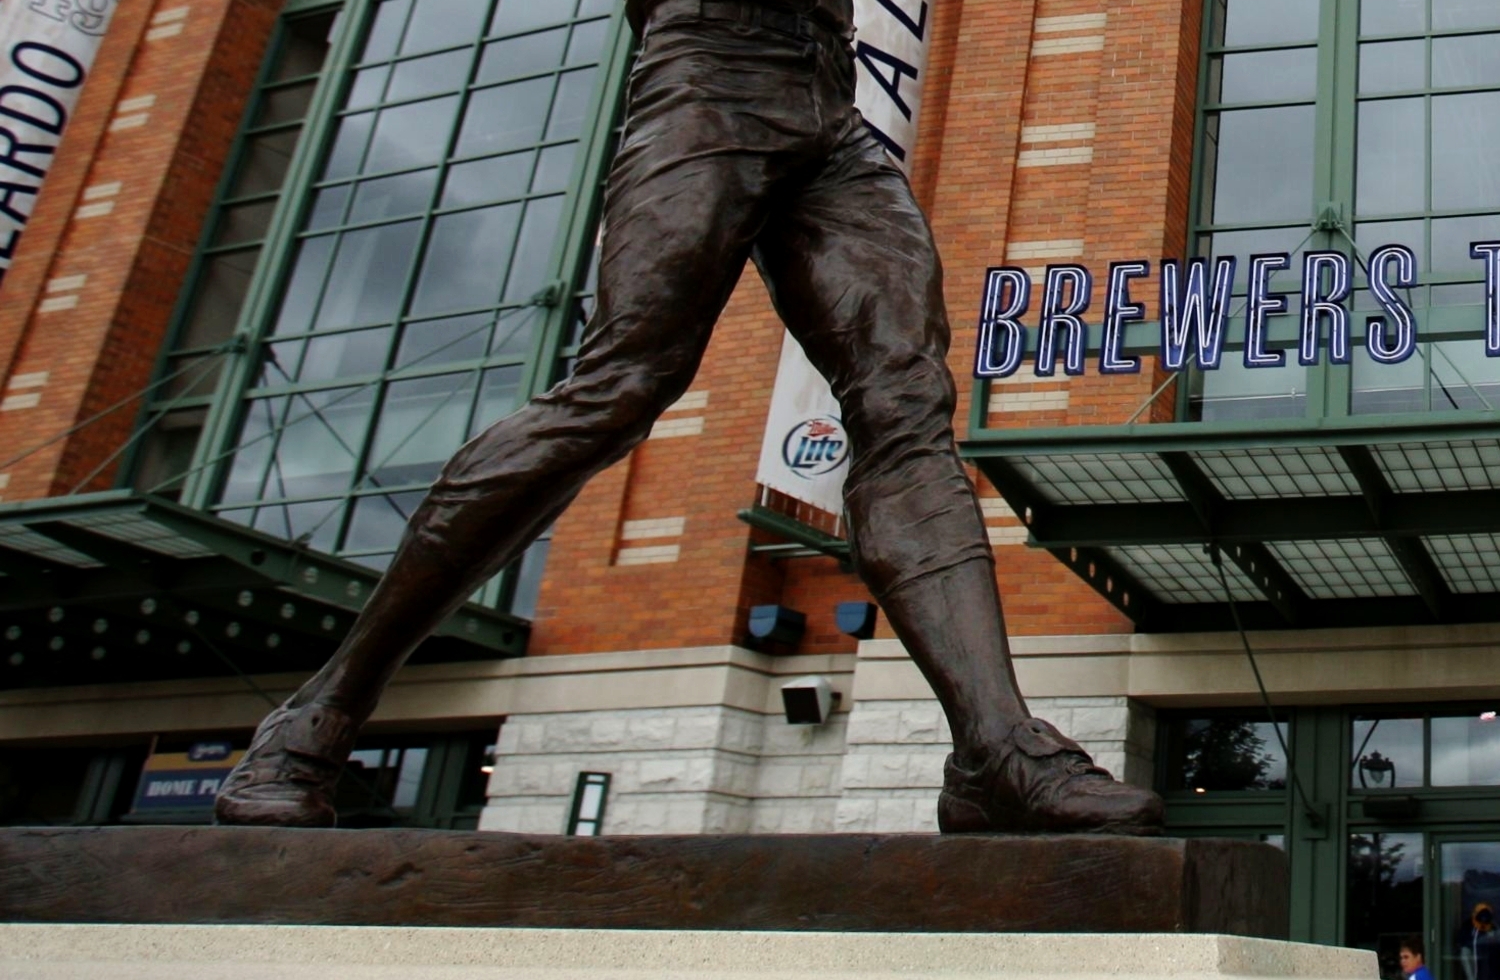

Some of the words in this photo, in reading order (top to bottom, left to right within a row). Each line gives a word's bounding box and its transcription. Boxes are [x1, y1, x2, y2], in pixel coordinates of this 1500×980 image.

[974, 243, 1417, 380] BREWERS
[791, 436, 843, 469] Lite
[147, 780, 195, 797] HOME
[199, 779, 221, 795] PL
